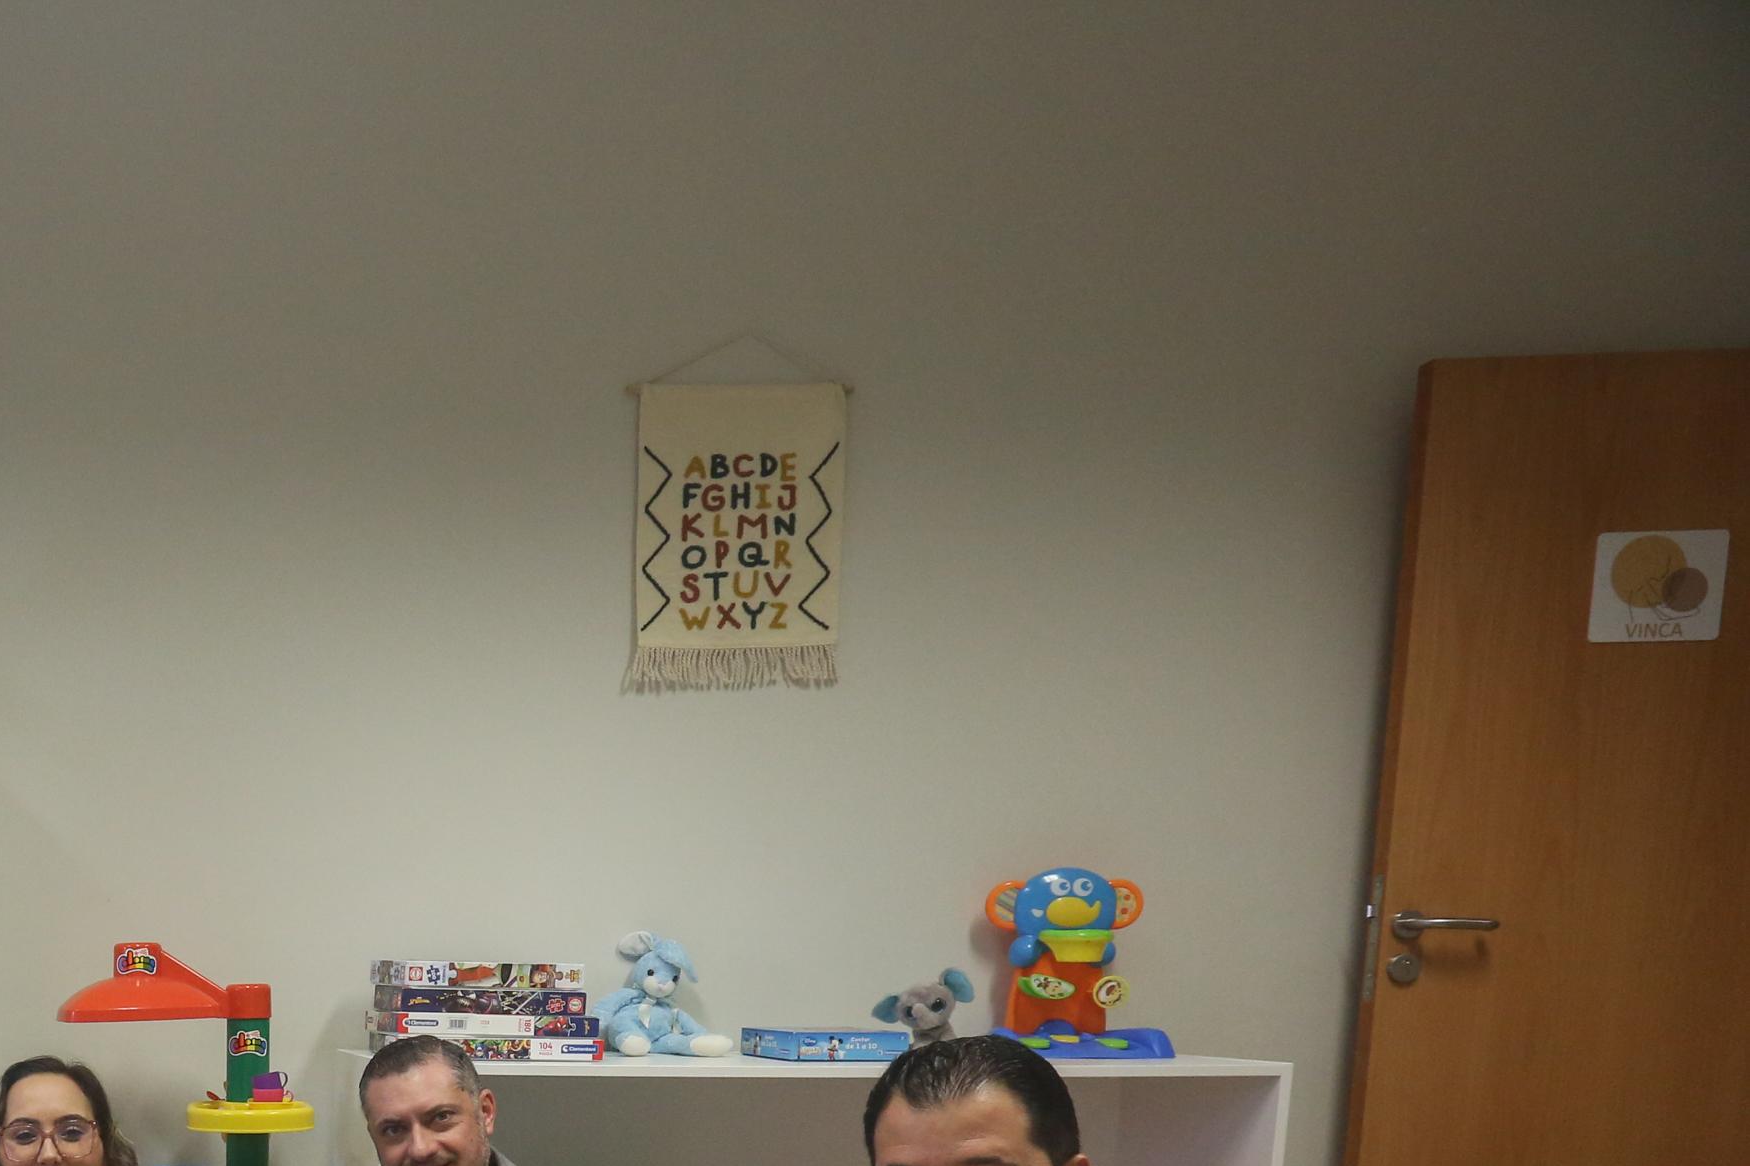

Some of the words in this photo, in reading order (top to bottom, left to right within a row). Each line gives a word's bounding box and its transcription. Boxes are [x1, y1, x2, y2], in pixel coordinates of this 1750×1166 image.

[683, 452, 798, 482] ABCDE
[682, 482, 798, 512] FGHIJ
[1625, 623, 1683, 638] VINCA
[539, 1042, 553, 1050] 104
